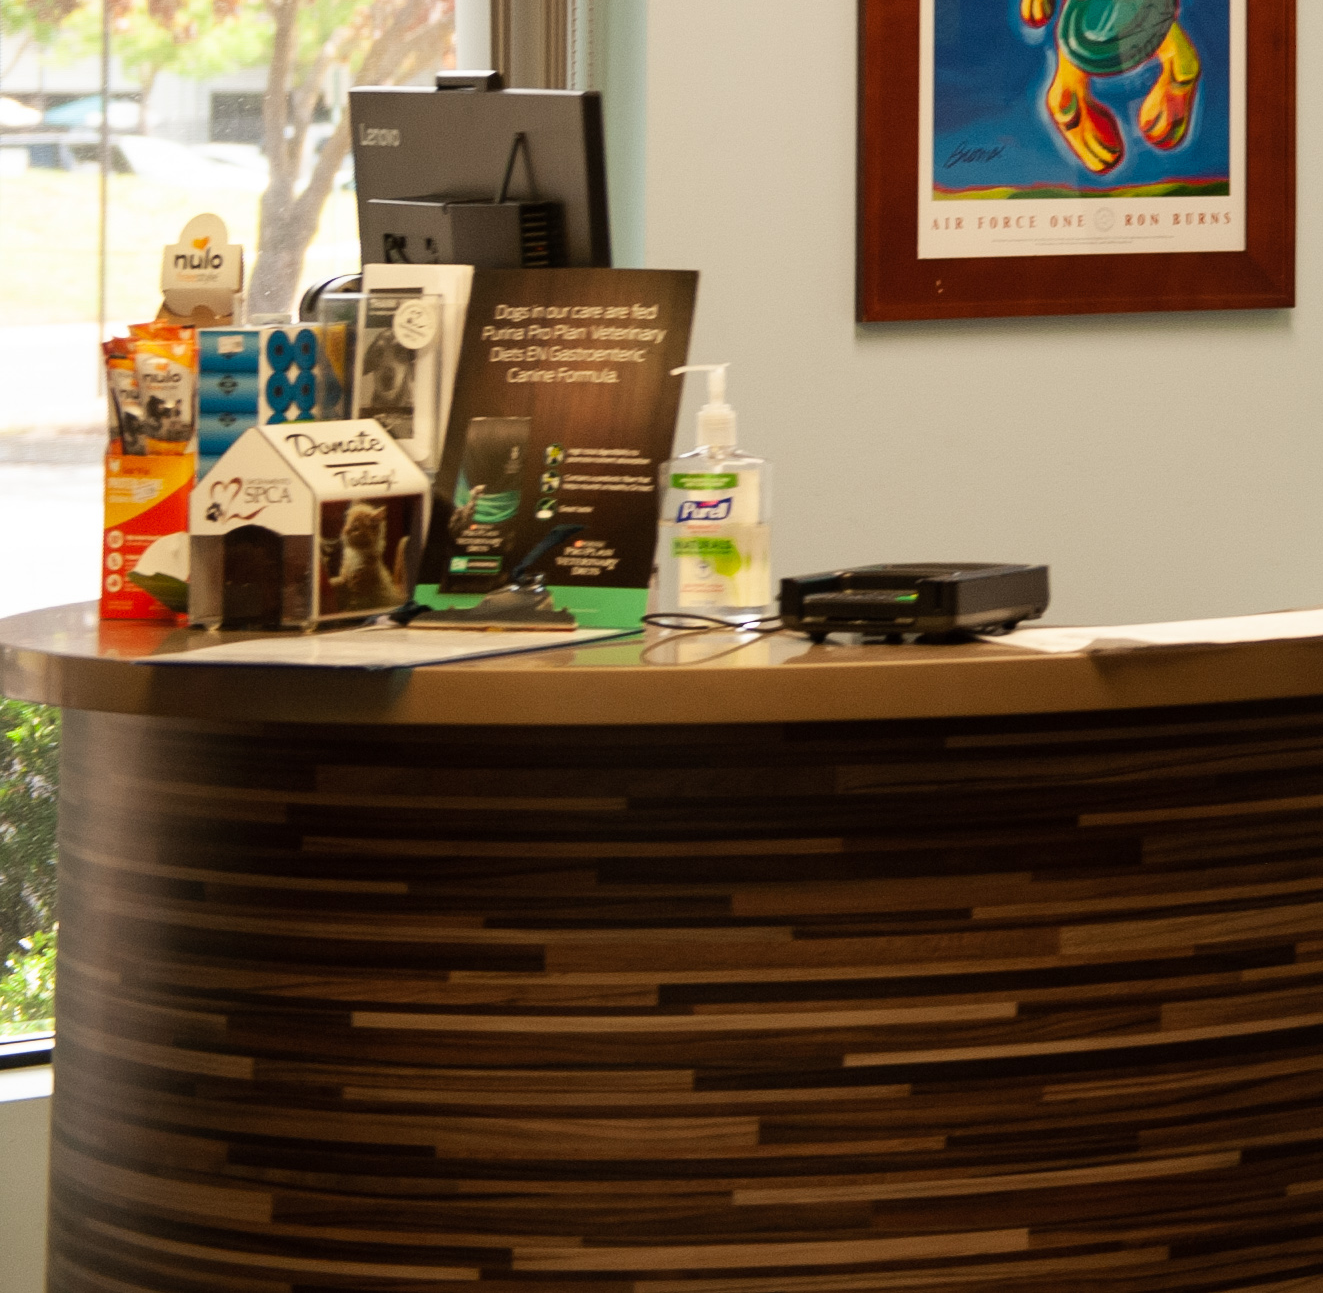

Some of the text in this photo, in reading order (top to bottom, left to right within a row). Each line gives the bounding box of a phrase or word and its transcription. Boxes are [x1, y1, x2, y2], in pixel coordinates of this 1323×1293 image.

[930, 212, 1232, 230] AIR FORCE ONE RON BURNS
[174, 247, 223, 270] nulo
[285, 431, 385, 457] Donate
[244, 485, 293, 504] SPCA
